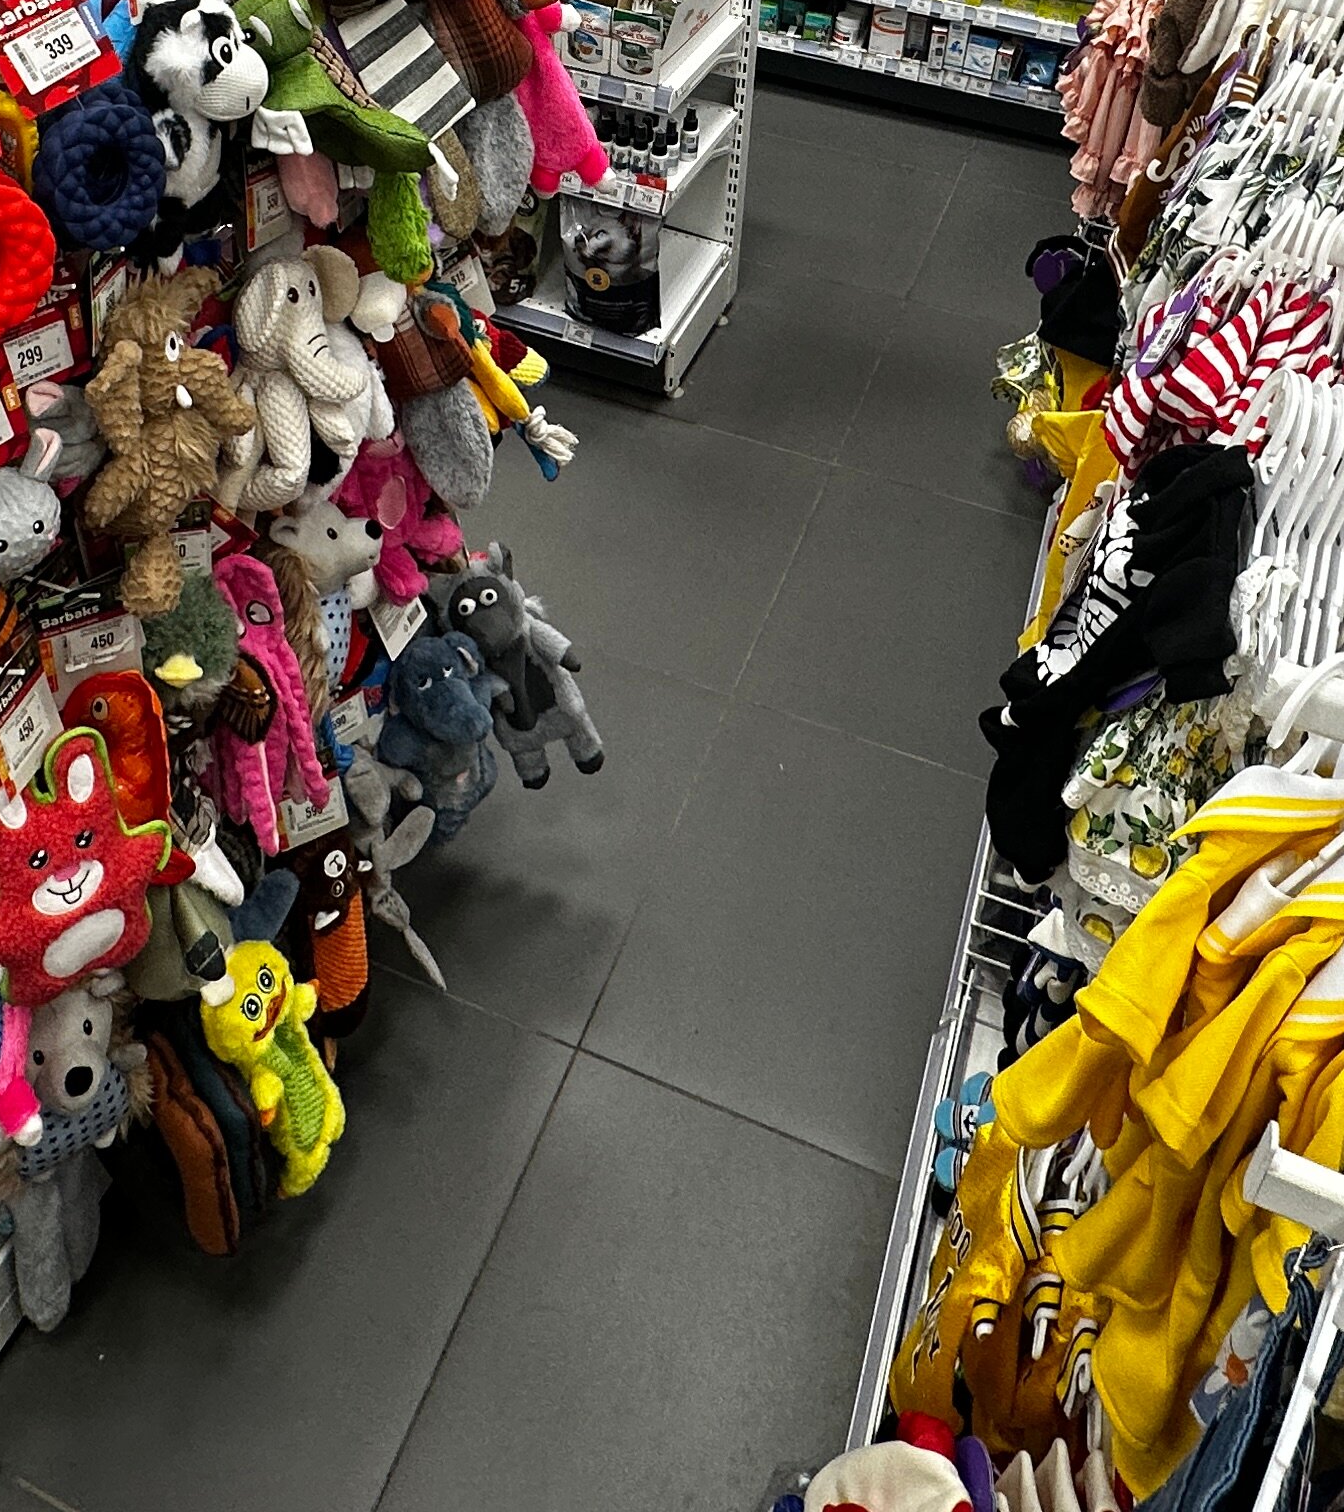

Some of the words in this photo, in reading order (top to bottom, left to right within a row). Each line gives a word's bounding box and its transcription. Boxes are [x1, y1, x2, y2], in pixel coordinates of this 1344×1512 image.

[42, 32, 76, 61] 339
[17, 344, 44, 371] 299
[37, 603, 101, 630] Barbaks
[89, 630, 115, 649] 450
[17, 717, 37, 743] 450
